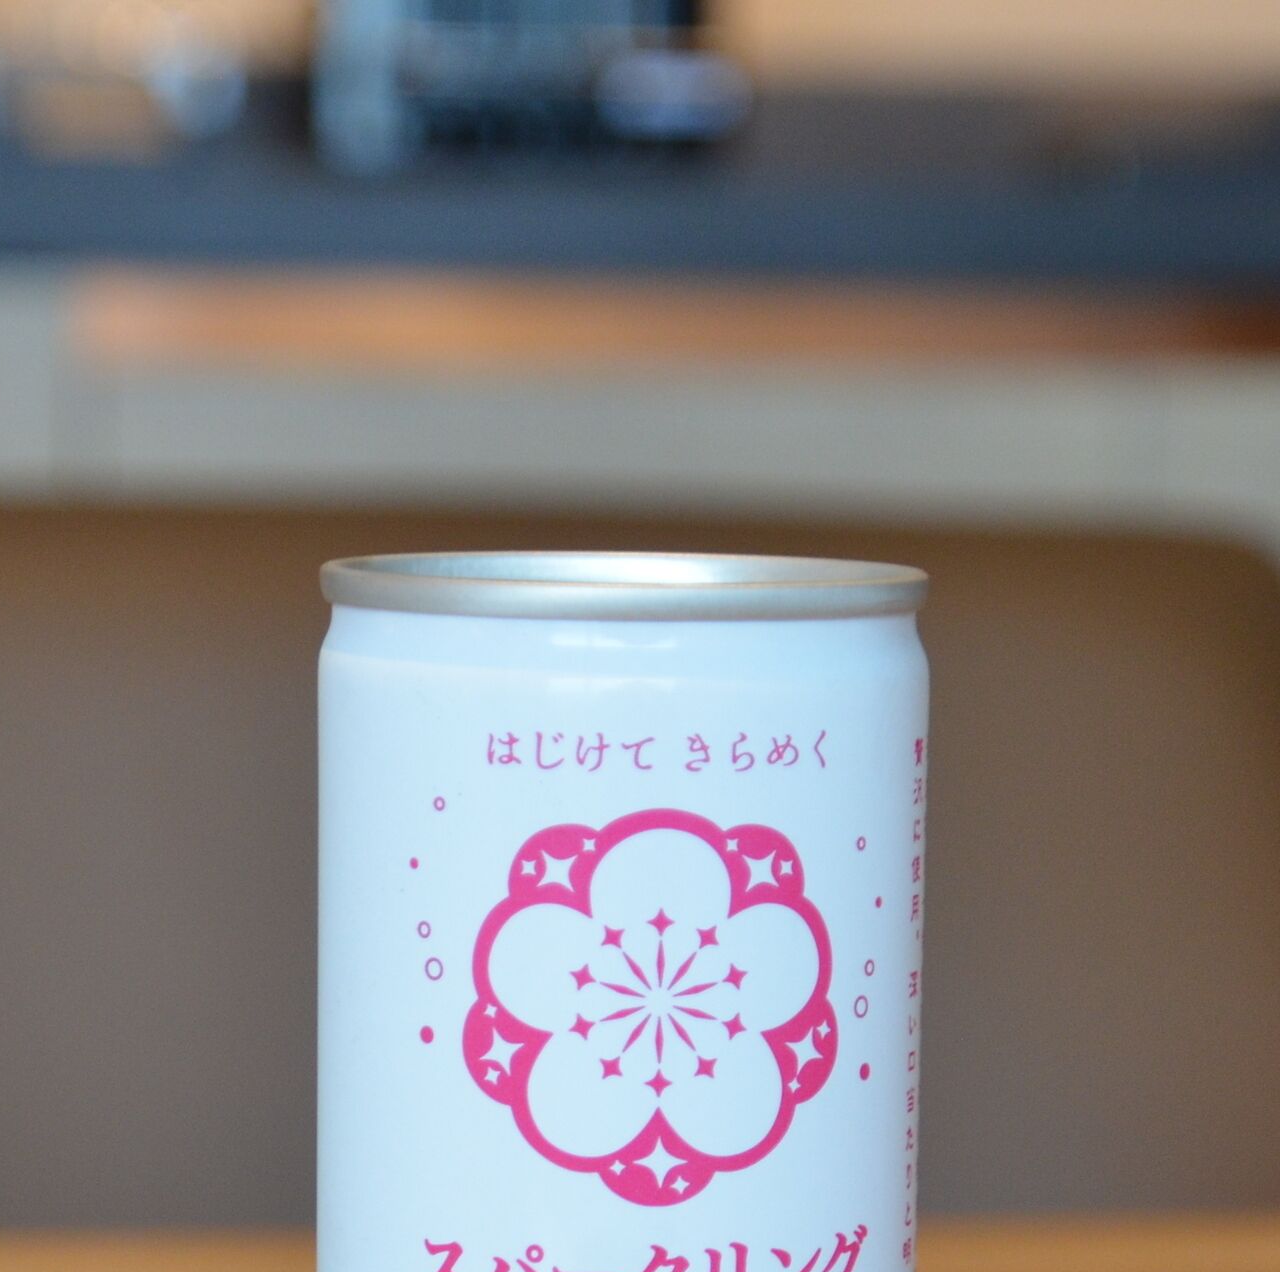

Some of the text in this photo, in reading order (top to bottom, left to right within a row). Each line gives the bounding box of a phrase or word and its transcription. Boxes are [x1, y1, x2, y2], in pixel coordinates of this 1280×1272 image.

[487, 730, 829, 772] はじけて きらめく
